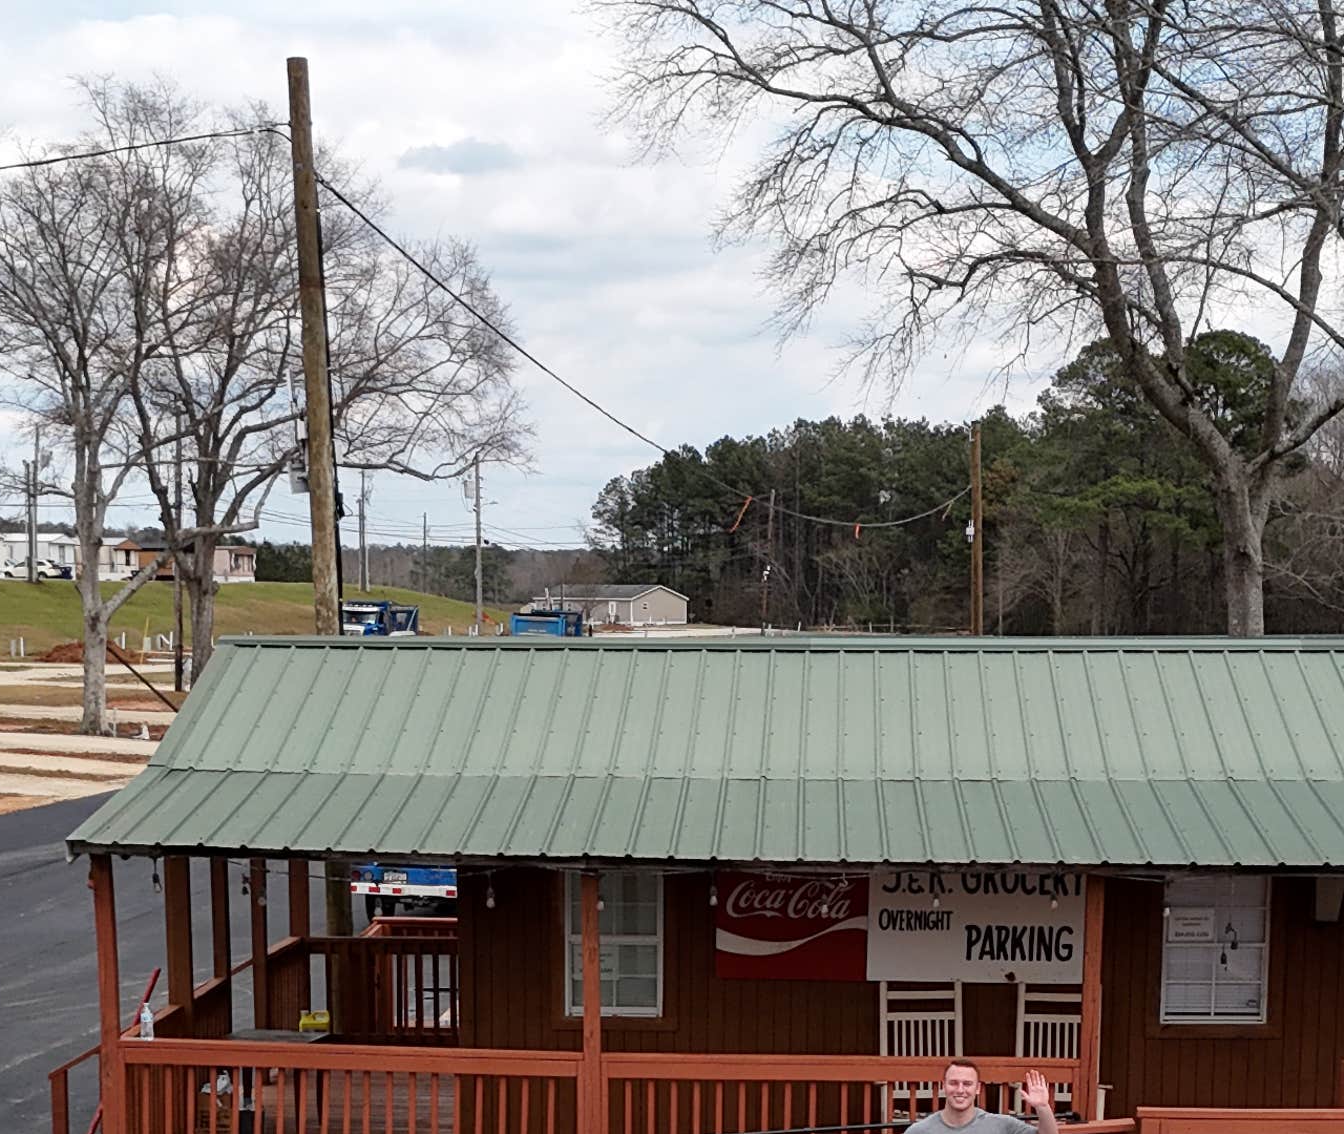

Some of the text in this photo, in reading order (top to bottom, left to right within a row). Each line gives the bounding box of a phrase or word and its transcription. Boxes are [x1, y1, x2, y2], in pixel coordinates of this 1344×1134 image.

[726, 879, 855, 919] Coca-Cola
[878, 908, 954, 931] OVERNIGHT
[964, 924, 1074, 962] PARKING
